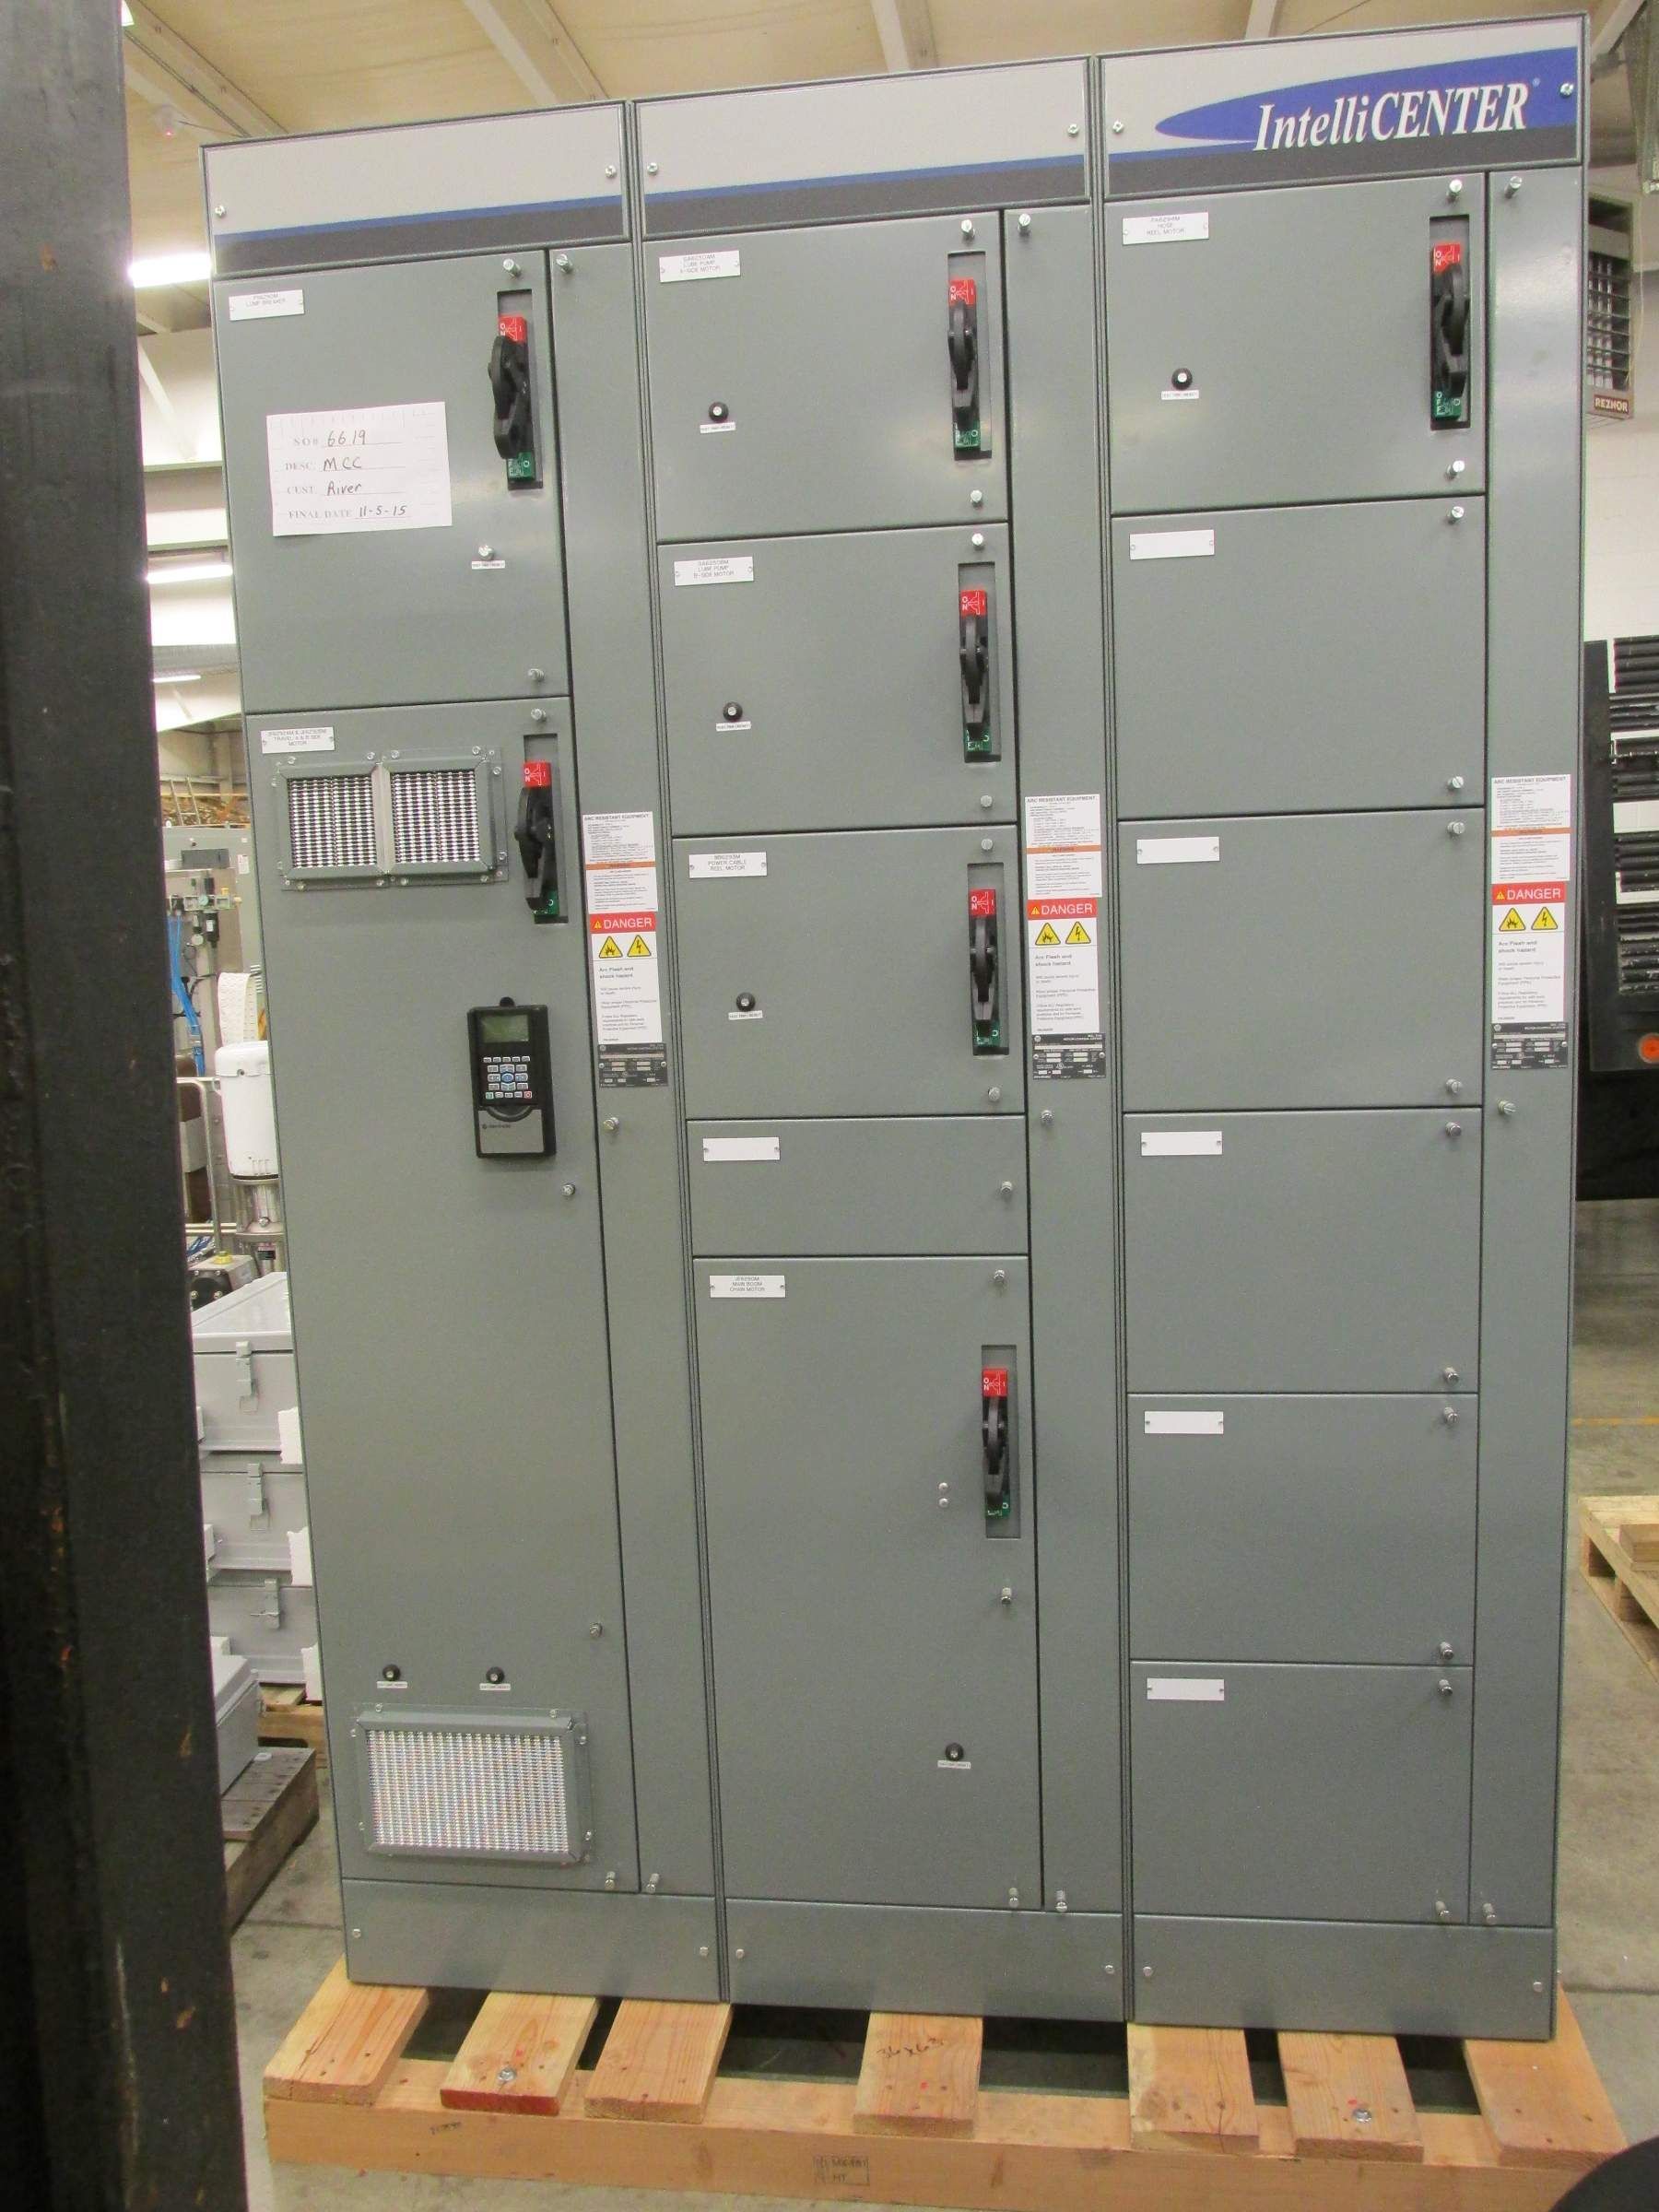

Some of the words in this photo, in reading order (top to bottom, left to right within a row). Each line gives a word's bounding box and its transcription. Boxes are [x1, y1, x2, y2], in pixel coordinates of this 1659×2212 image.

[1253, 81, 1529, 151] IntelliCENTER
[1595, 397, 1628, 412] REZNOR
[327, 429, 367, 447] 6619
[323, 457, 362, 471] MCC
[327, 480, 362, 496] River
[359, 505, 407, 517] 11-5-15
[962, 595, 969, 611] ON
[524, 767, 531, 782] ON
[1506, 888, 1561, 900] DANGER
[971, 895, 978, 910] ON
[1041, 903, 1093, 915] DANGER
[603, 918, 652, 929] DANGER
[983, 1377, 990, 1391] ON
